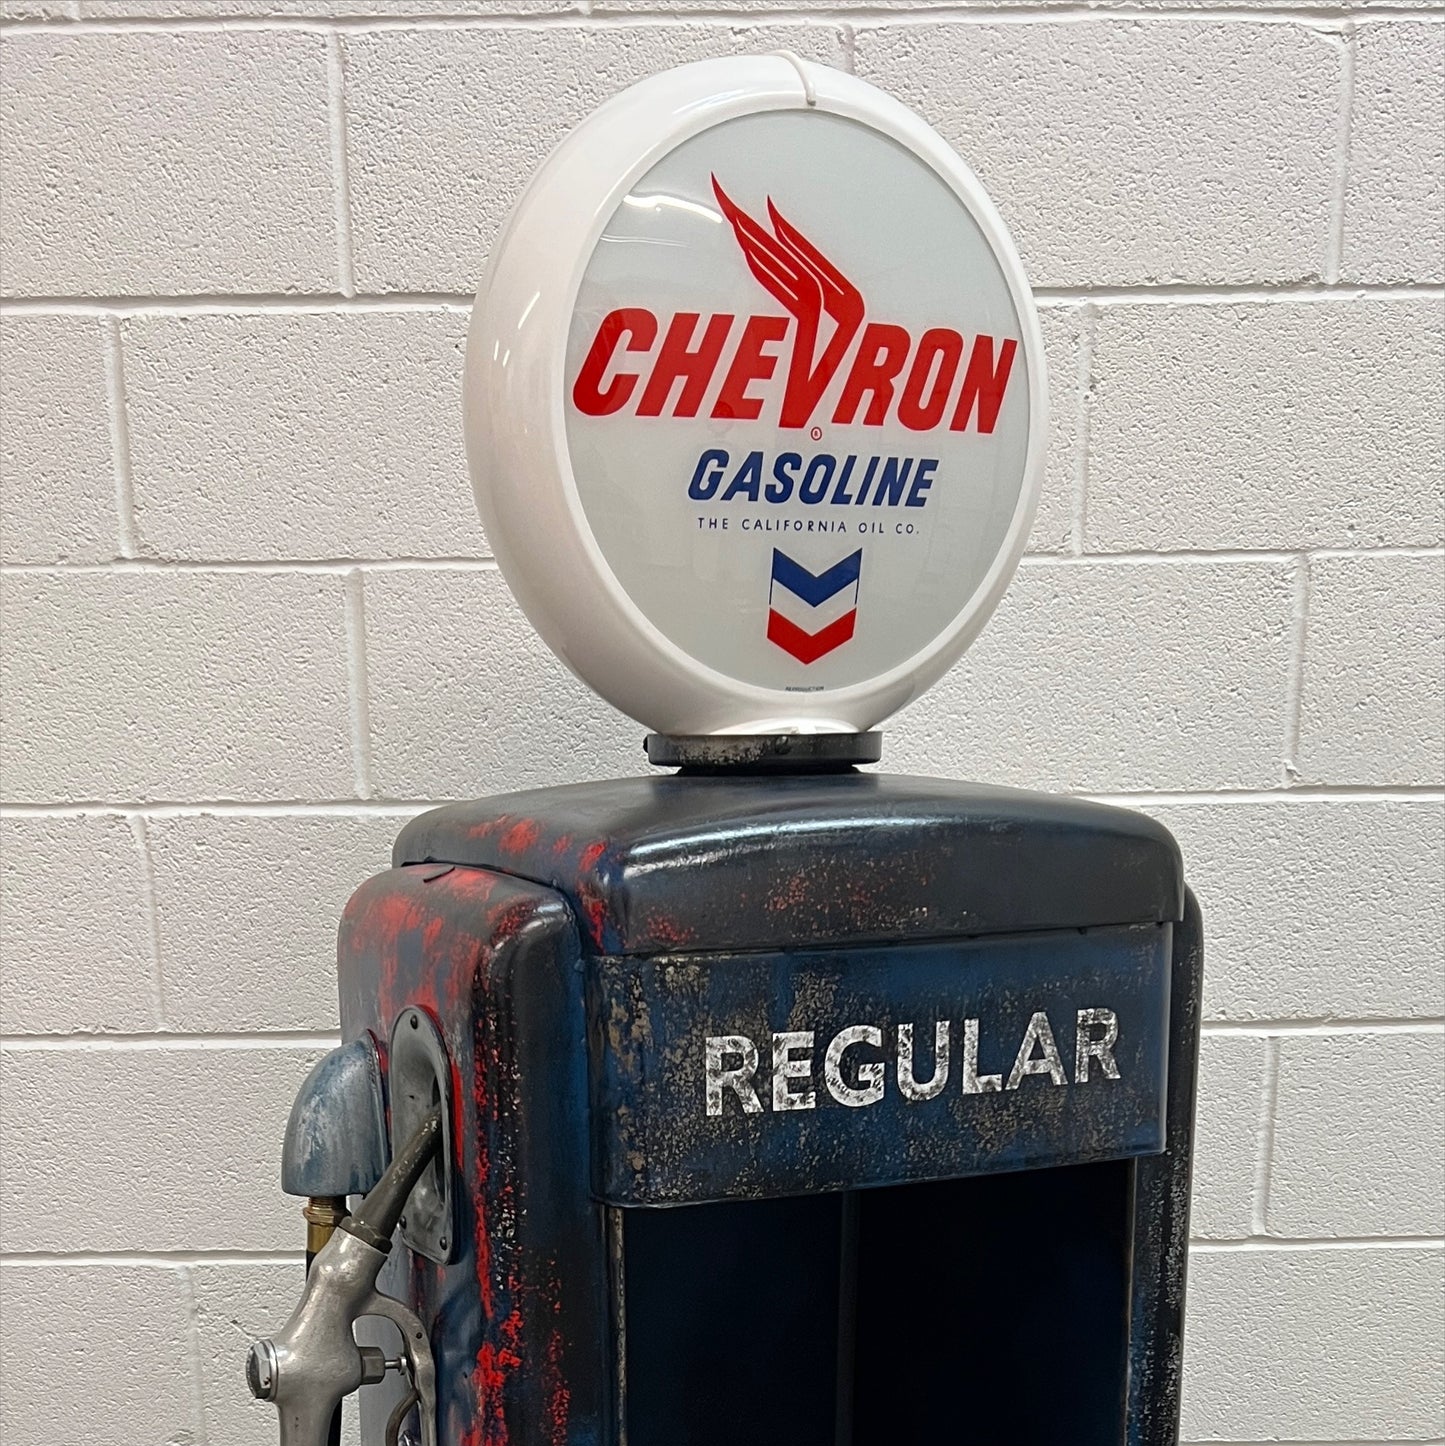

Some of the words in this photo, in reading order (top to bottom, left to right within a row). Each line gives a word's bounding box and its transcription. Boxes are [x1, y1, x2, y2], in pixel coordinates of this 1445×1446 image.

[572, 295, 1018, 434] CHEVRON
[687, 449, 940, 508] GASOLINE
[697, 517, 729, 530] THE
[741, 518, 847, 533] CALIFORNIA
[858, 522, 884, 534] OIL
[895, 523, 920, 535] CO.
[704, 1007, 1121, 1117] REGULAR
